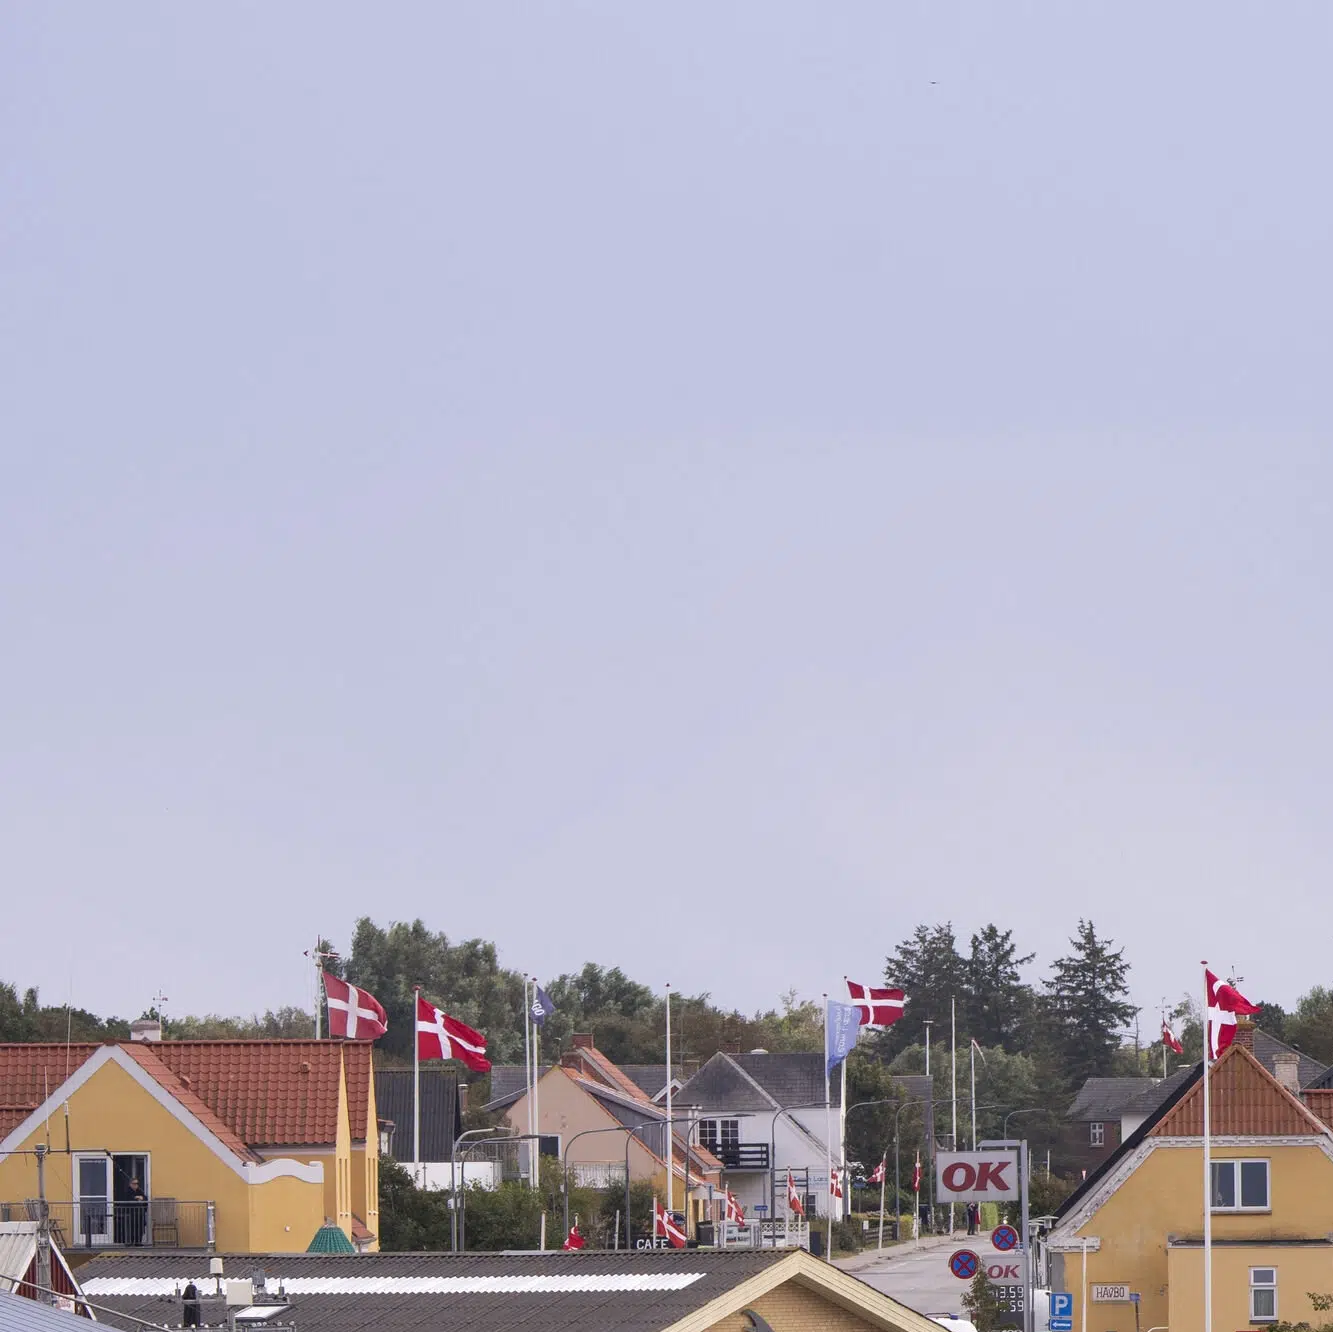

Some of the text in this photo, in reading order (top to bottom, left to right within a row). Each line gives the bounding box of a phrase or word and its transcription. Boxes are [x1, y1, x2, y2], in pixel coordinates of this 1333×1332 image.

[941, 1161, 1012, 1192] OK
[987, 1264, 1020, 1279] OK
[1054, 1295, 1068, 1314] P
